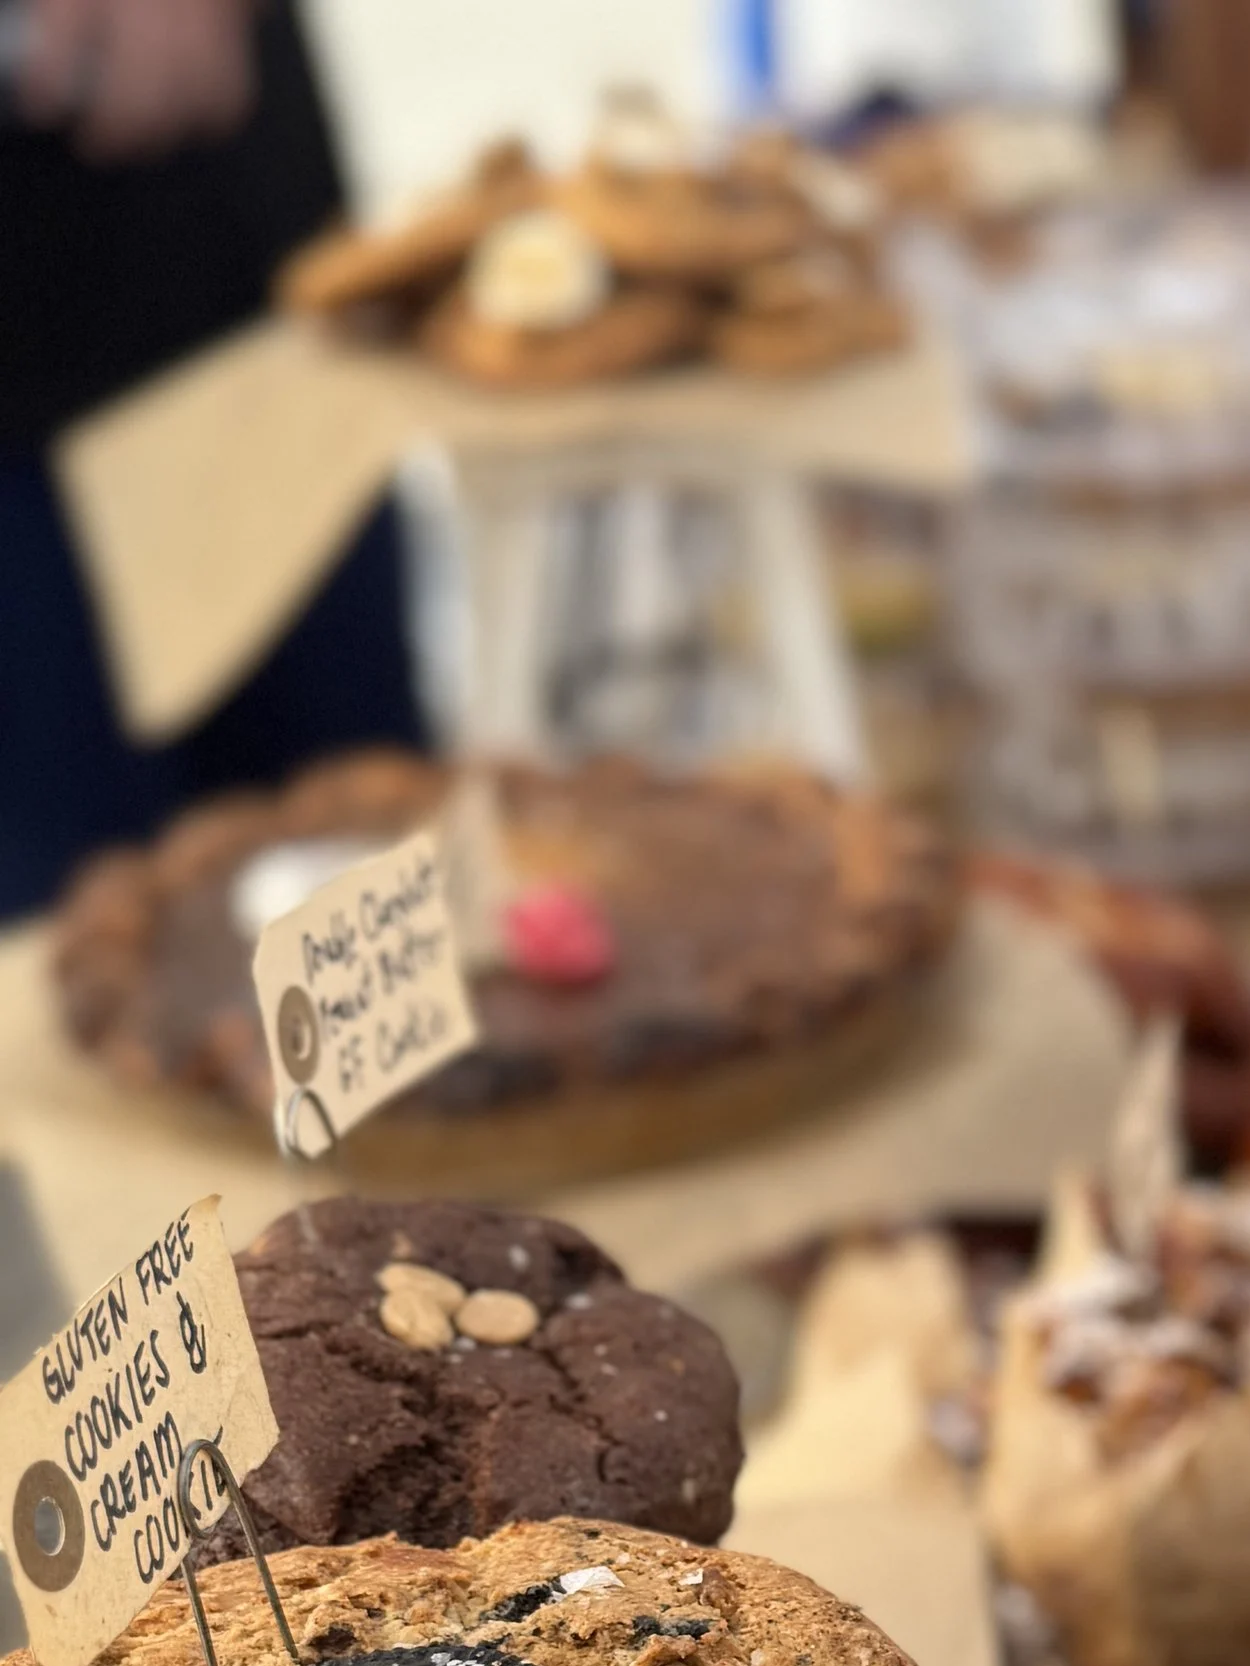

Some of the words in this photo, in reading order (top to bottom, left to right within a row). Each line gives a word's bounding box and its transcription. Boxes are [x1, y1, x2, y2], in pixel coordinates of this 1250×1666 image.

[42, 1276, 128, 1405] GLUTEN
[135, 1205, 194, 1306] FREE
[64, 1329, 170, 1482] COOKIES
[176, 1290, 207, 1374] &
[91, 1411, 182, 1552] CREAM
